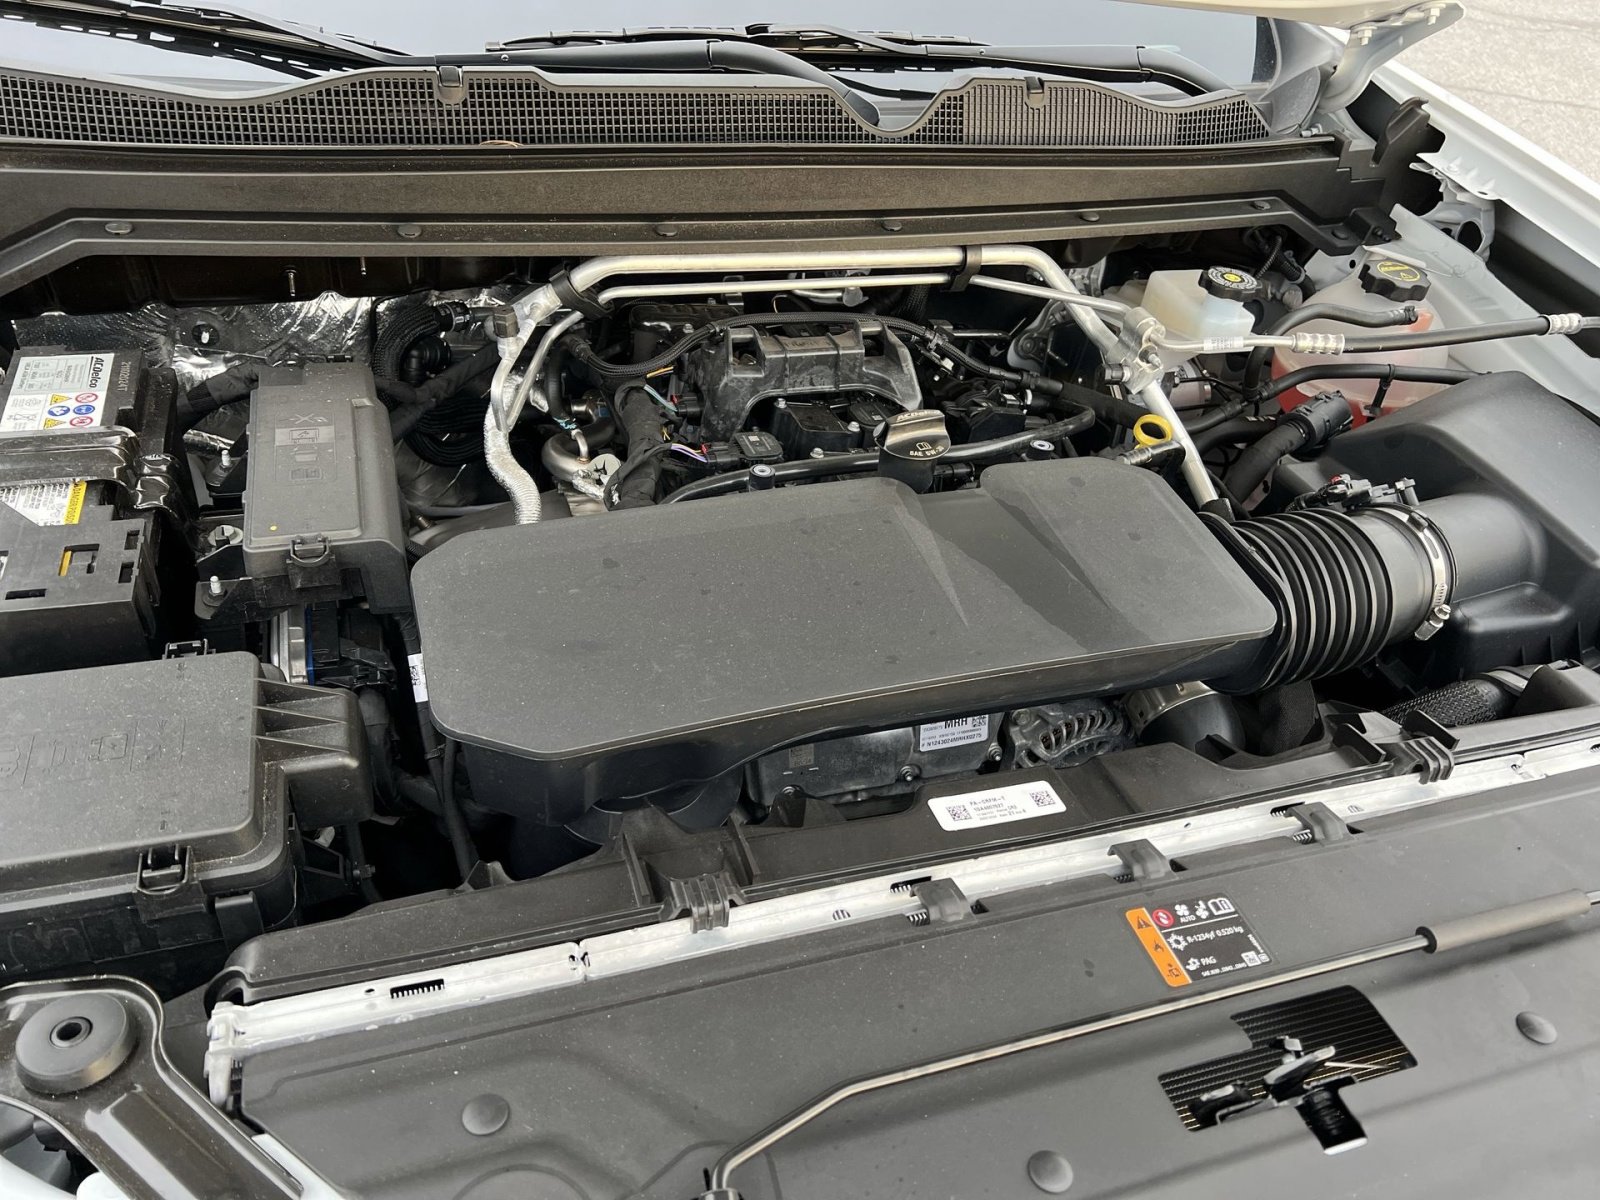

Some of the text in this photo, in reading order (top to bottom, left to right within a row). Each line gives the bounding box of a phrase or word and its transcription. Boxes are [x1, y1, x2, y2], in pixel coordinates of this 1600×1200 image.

[88, 357, 105, 389] ACDelco
[944, 717, 968, 729] MRH
[1180, 914, 1196, 924] AUTO
[1187, 925, 1245, 943] R-1234yf 0.520 kg
[1200, 956, 1217, 967] PAG
